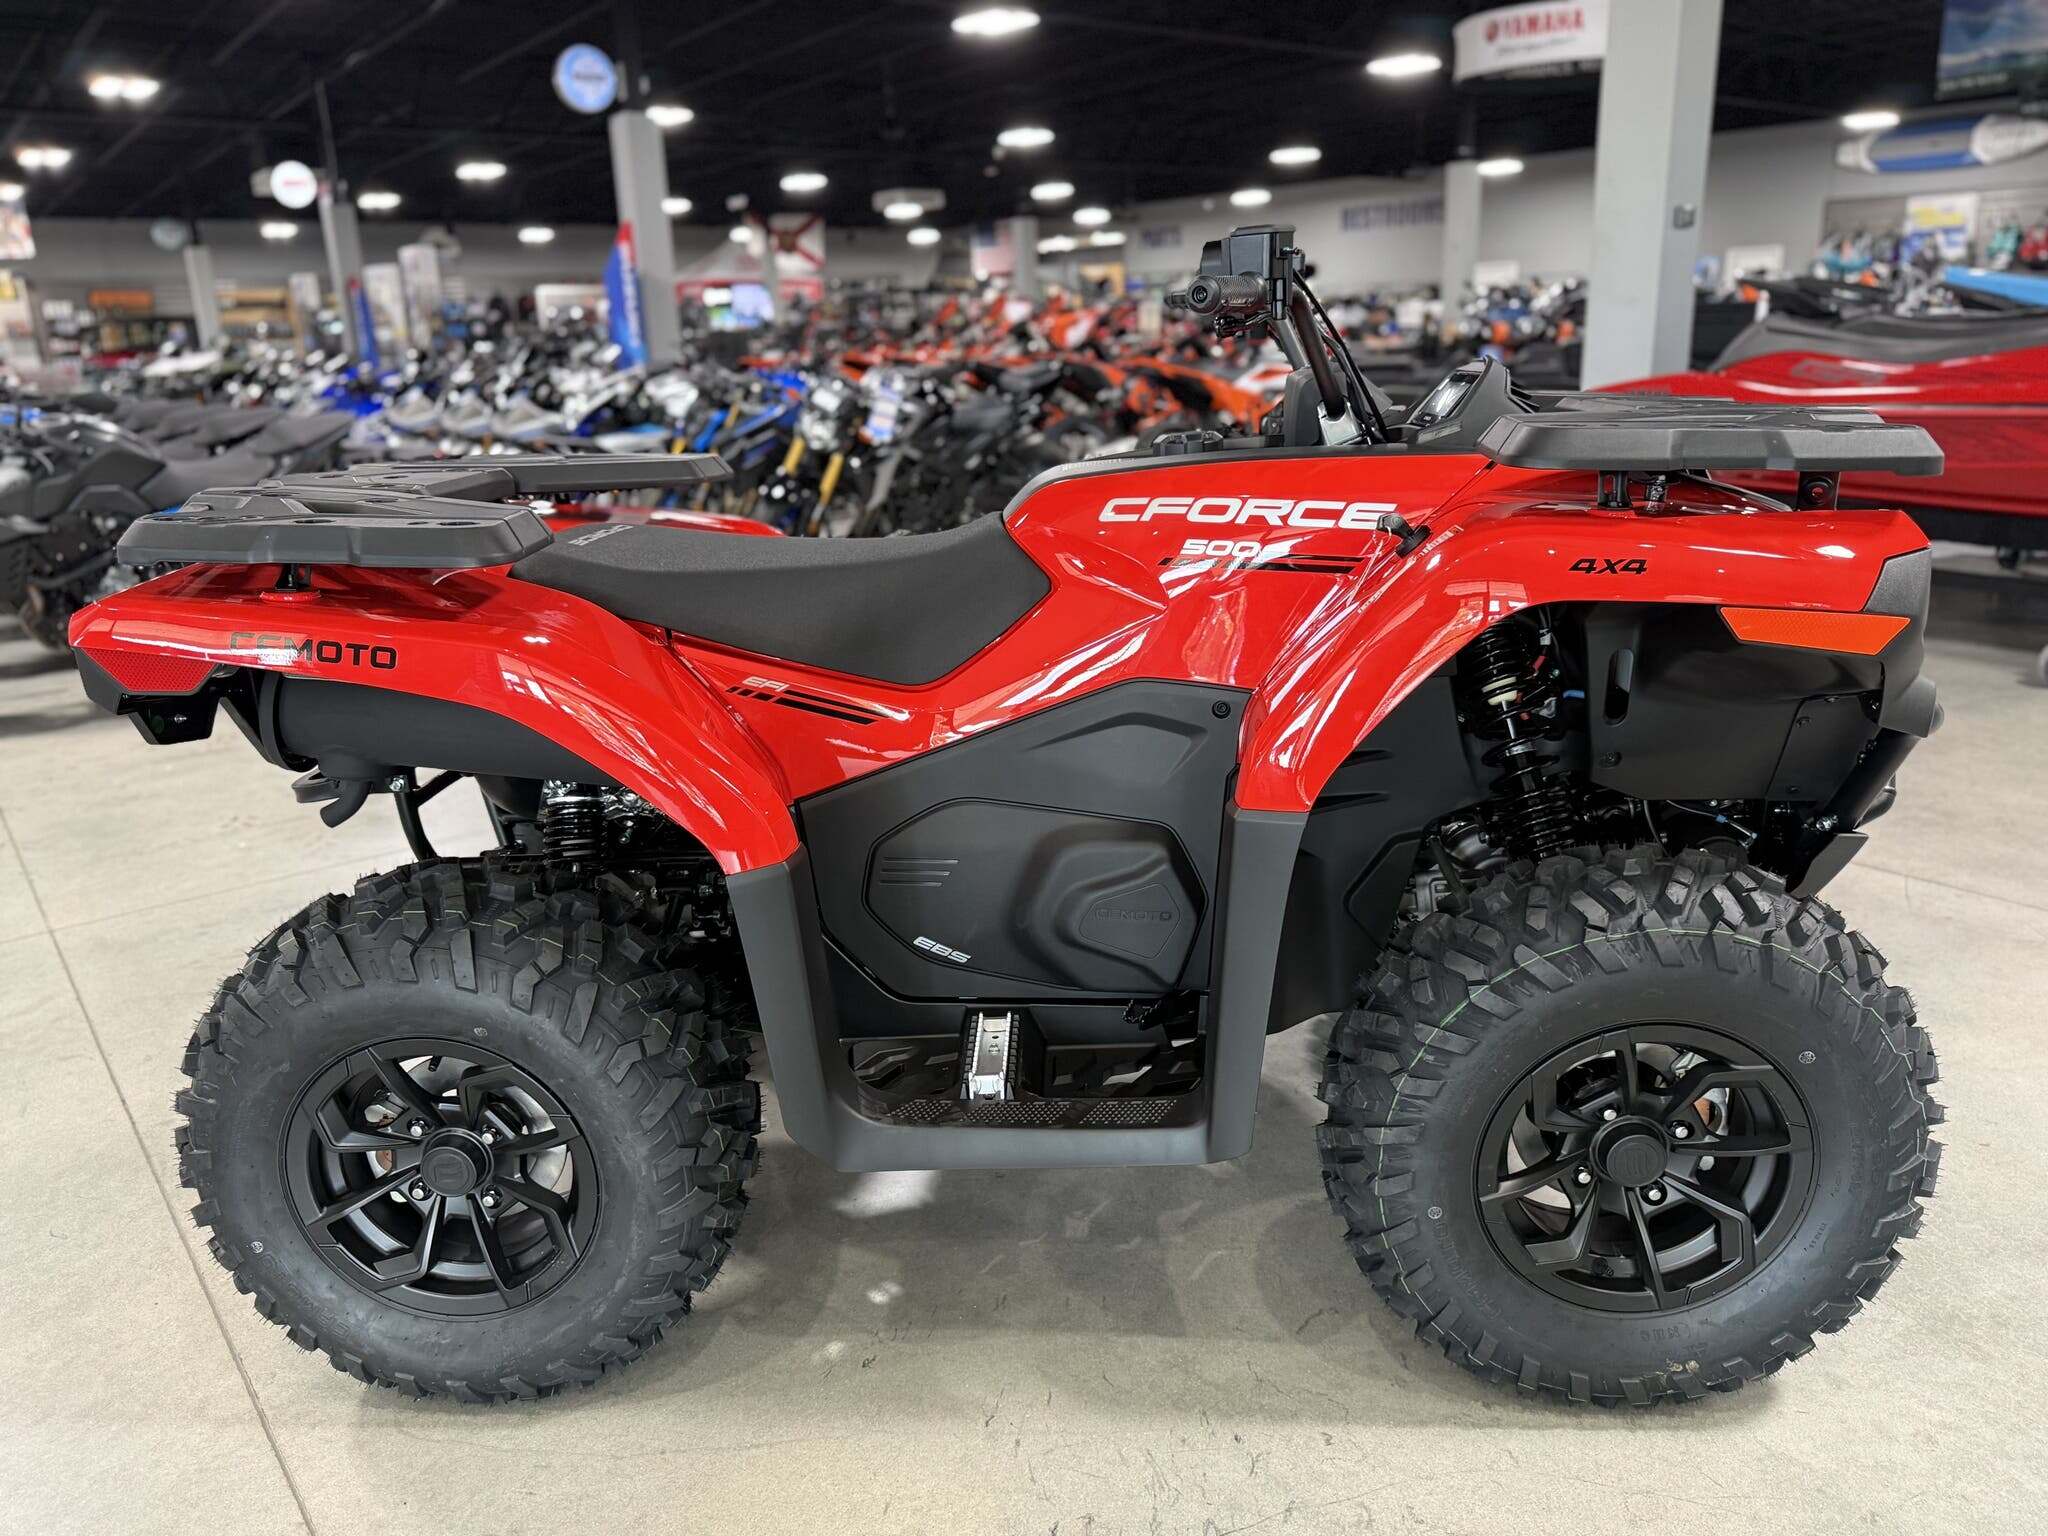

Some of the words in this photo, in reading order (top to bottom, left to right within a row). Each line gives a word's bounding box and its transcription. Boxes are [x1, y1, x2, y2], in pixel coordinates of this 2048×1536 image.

[1499, 7, 1584, 39] YAMAHA
[1098, 496, 1396, 530] CFORCE
[1180, 538, 1262, 558] 500
[742, 675, 790, 692] EFI
[913, 936, 972, 963] EBS
